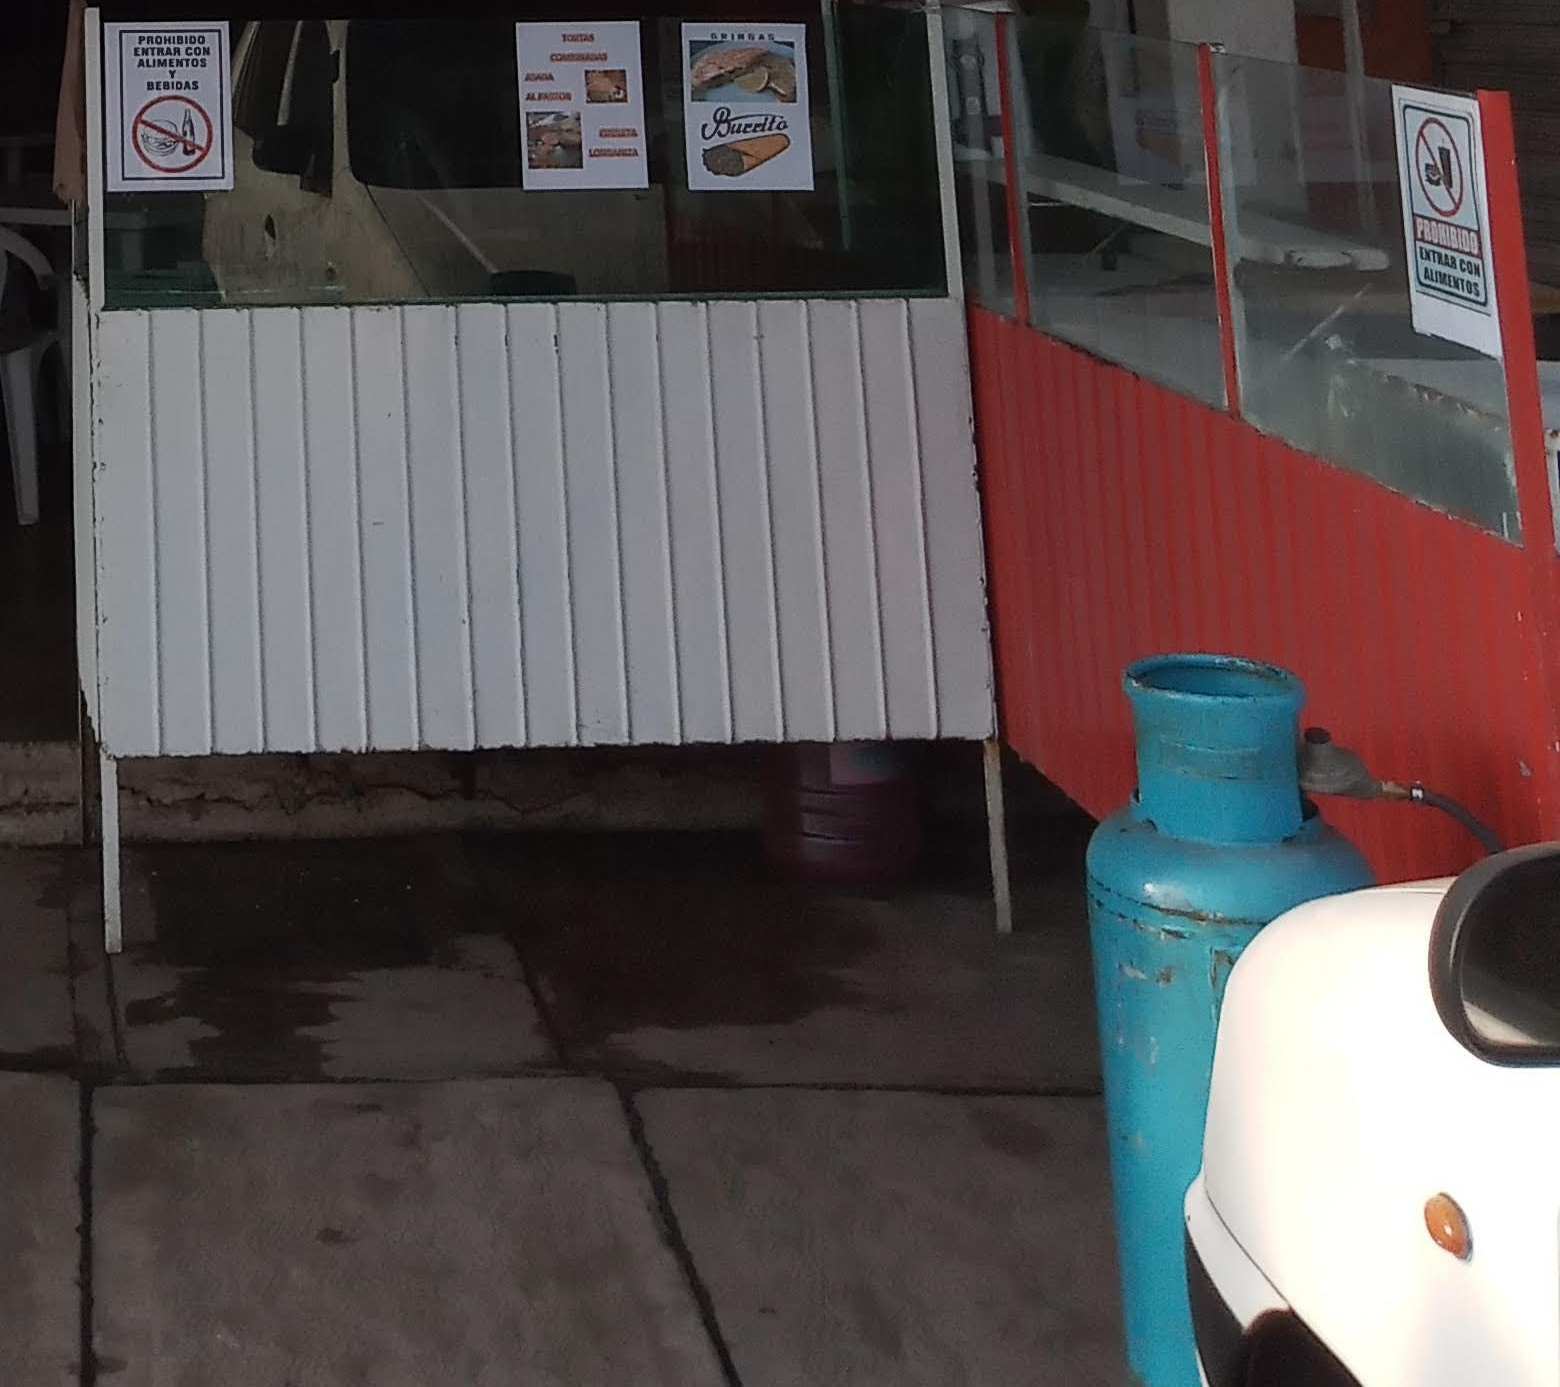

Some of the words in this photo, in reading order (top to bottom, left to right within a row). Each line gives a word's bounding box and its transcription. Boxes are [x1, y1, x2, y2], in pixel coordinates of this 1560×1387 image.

[138, 36, 206, 45] PROHIBIDO
[710, 33, 775, 41] GRINGAS
[134, 47, 180, 56] ENTRAR
[185, 47, 210, 56] CON
[137, 59, 206, 68] ALIMENTOS
[169, 70, 176, 79] Y
[147, 81, 199, 91] BEBIDAS
[701, 107, 788, 140] Burrito
[1416, 219, 1479, 255] PROHIBIDO
[1419, 246, 1457, 270] ENTRAR
[1460, 260, 1480, 277] CON
[1424, 266, 1480, 298] ALIMENTOS
